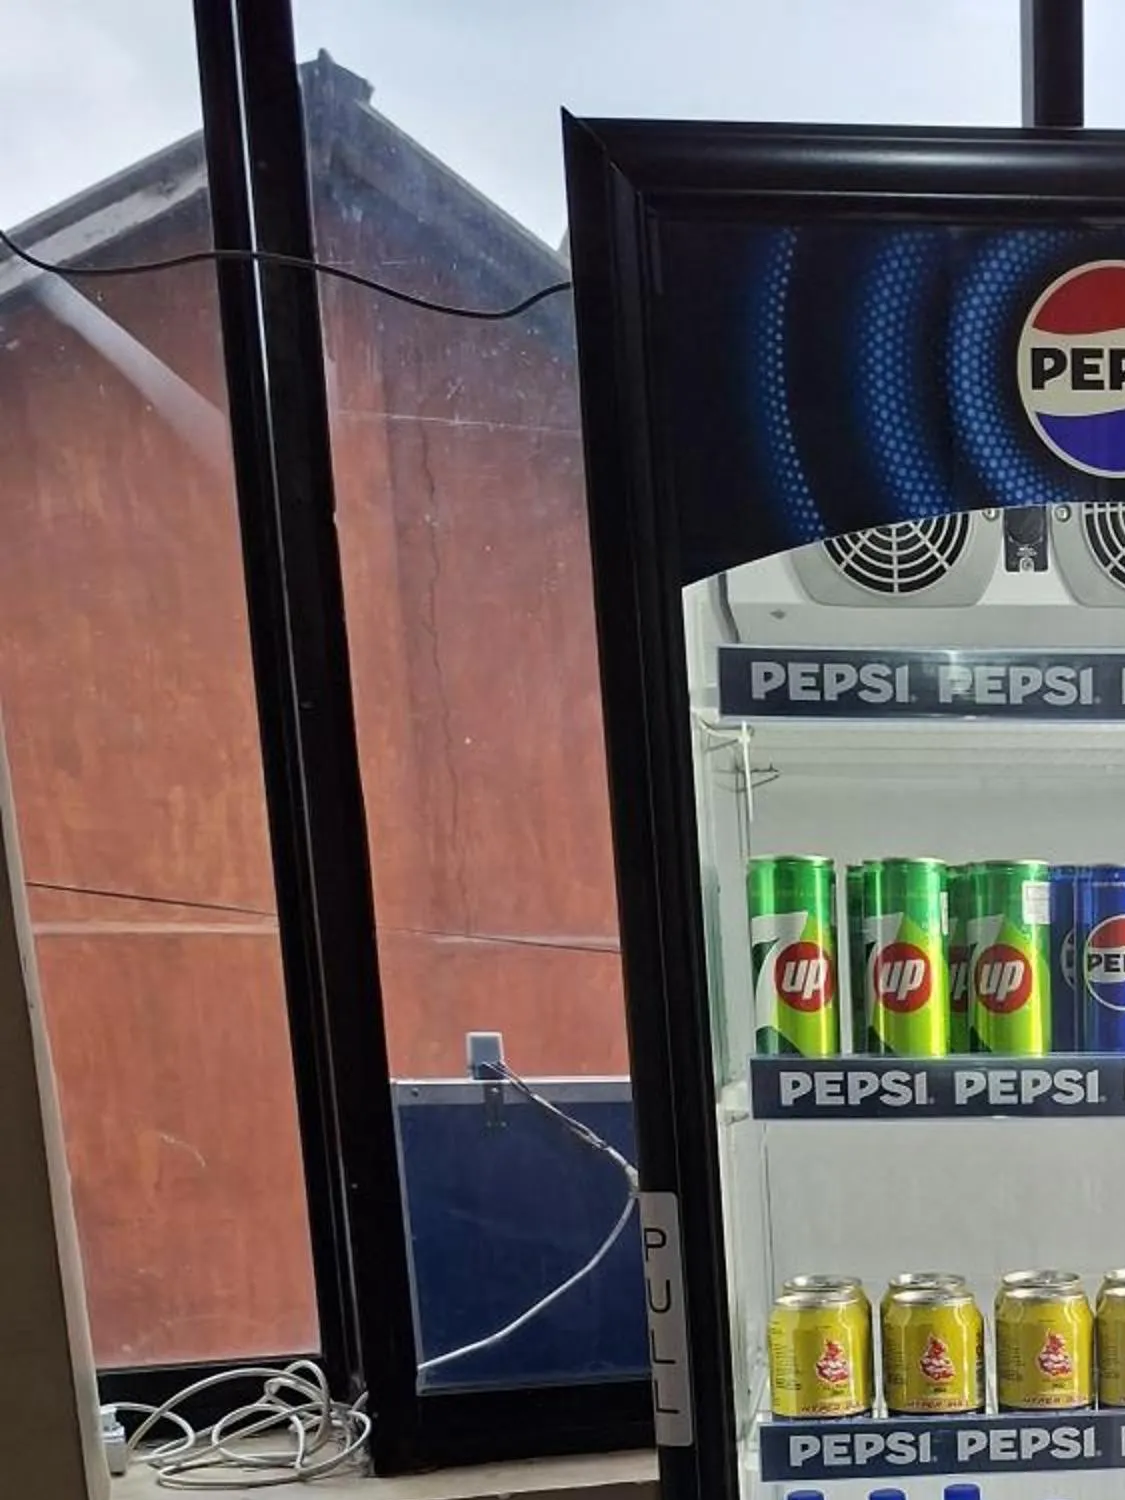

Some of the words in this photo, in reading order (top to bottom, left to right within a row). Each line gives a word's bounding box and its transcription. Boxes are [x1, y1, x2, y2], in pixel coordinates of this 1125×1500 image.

[752, 661, 909, 703] PEPSI
[939, 664, 1092, 705] PEPSI
[780, 1070, 927, 1106] PEPSI
[955, 1070, 1099, 1104] PEPSI
[643, 1227, 680, 1415] PULL
[790, 1432, 931, 1466] PEPSI
[958, 1427, 1095, 1461] PEPSI
